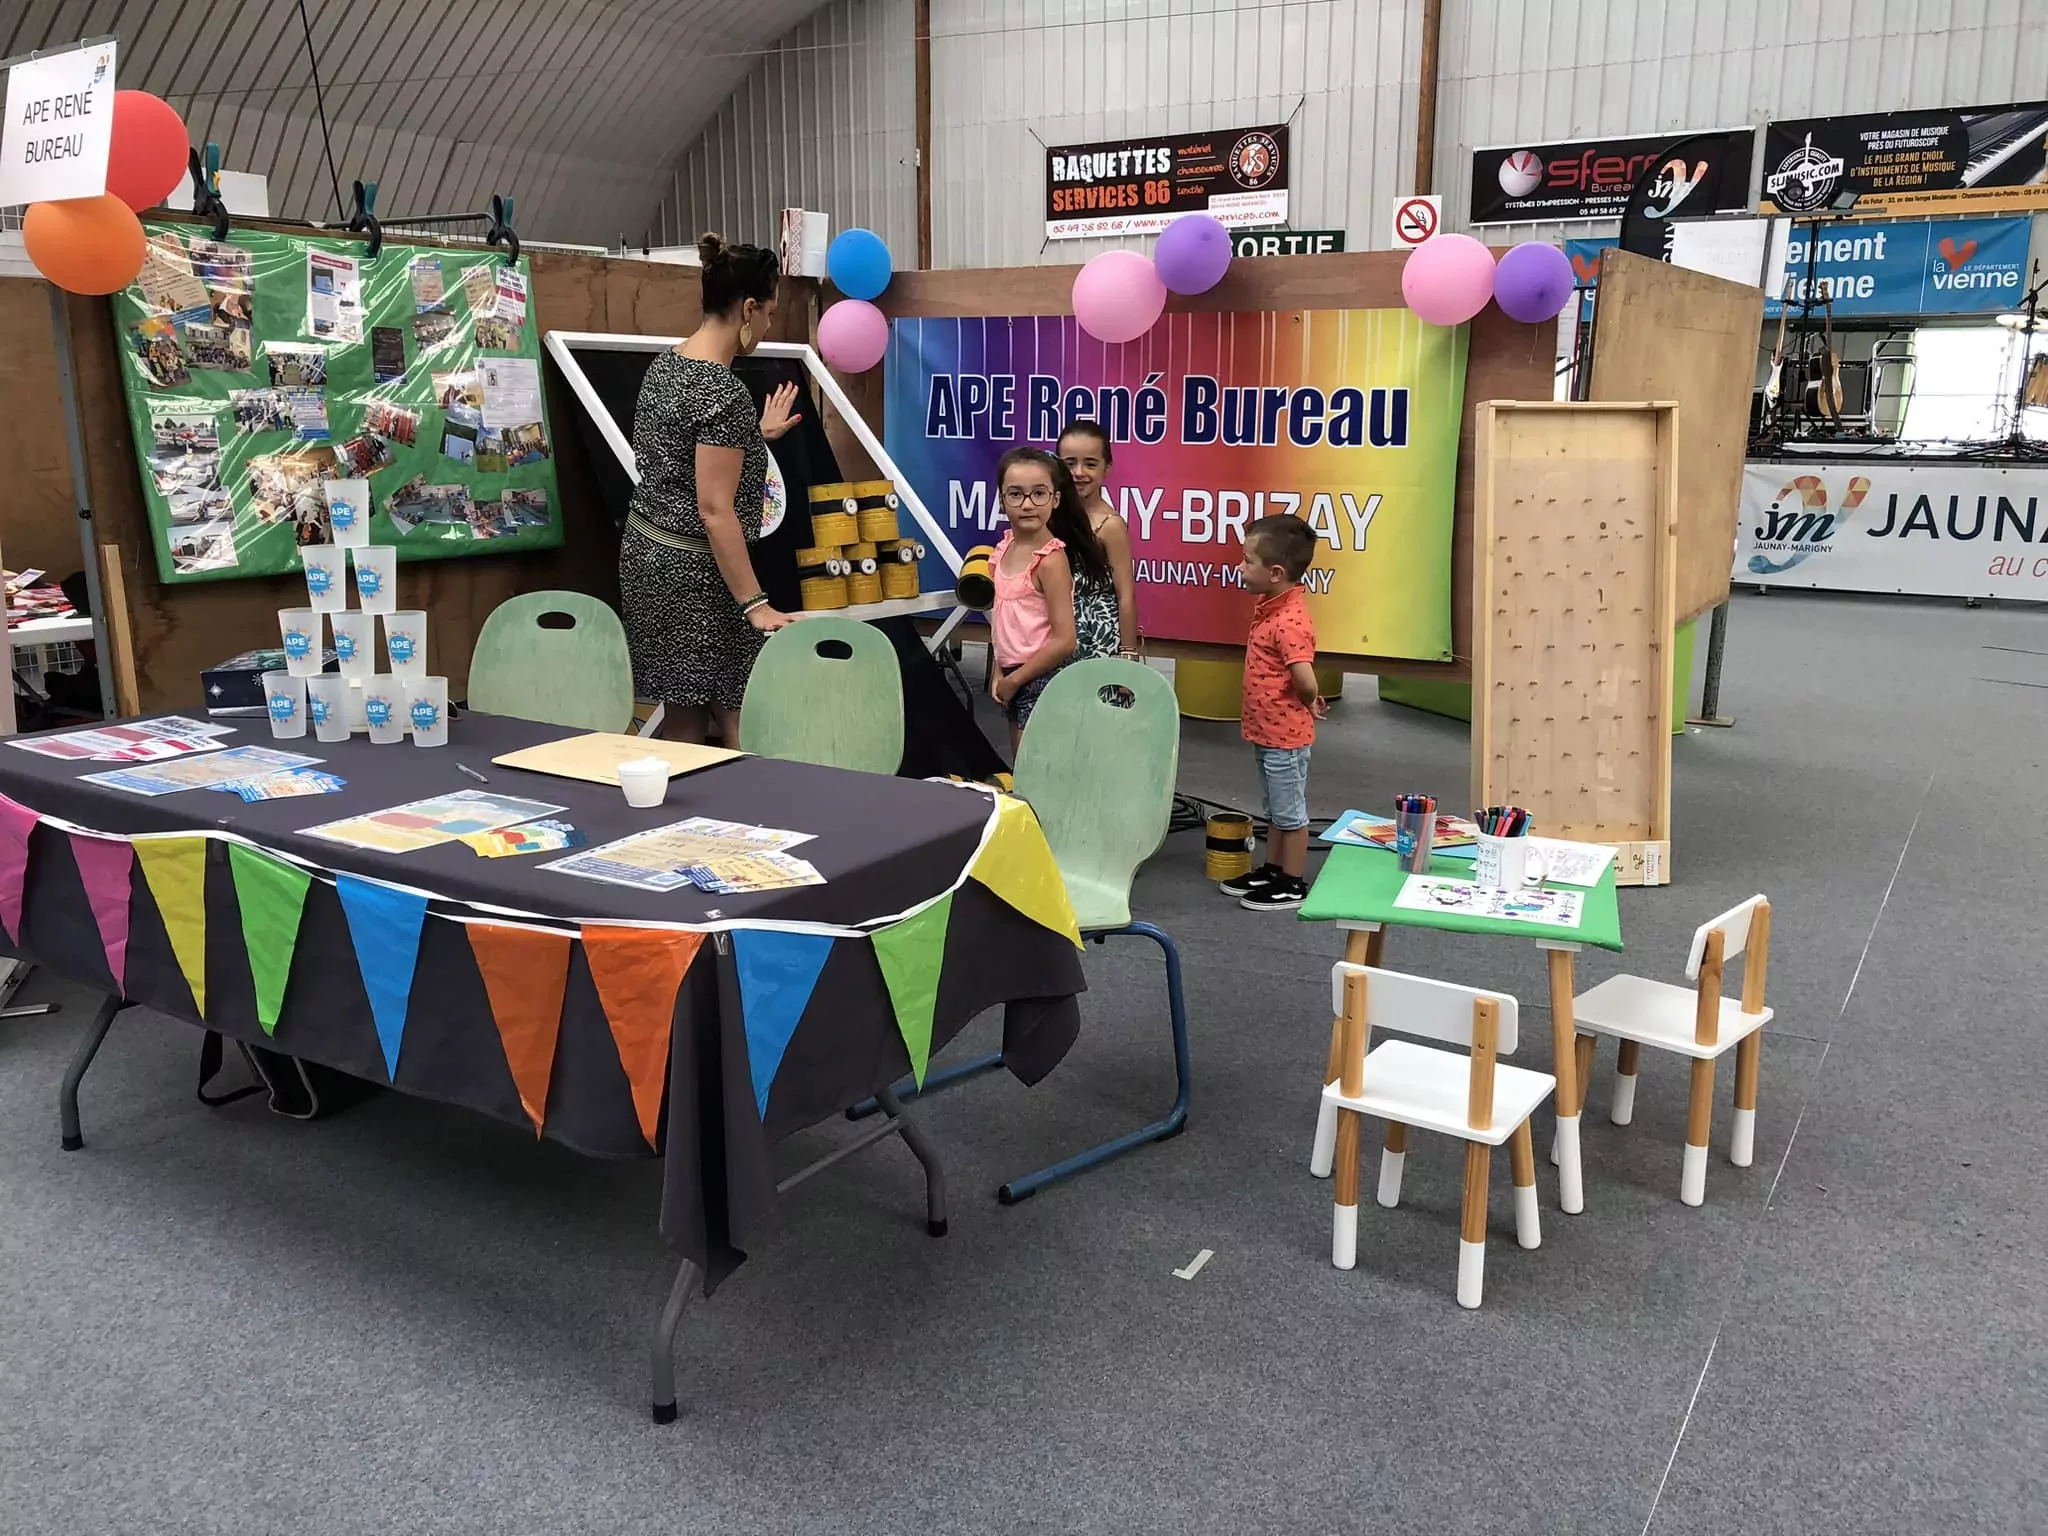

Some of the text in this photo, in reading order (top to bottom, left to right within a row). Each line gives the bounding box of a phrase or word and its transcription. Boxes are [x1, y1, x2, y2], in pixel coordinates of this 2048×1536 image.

[23, 82, 93, 126] APE RENÉ
[1860, 126, 1950, 141] VOTRE MAGASIN DE MUSIQUE
[25, 133, 83, 164] BUREAU
[1885, 141, 1894, 149] DU
[1895, 137, 1940, 149] FUTUROSCOPE
[1864, 150, 1945, 165] LE PLUS GRAND CHOIX
[1052, 146, 1171, 183] RAQUETTES
[1910, 164, 1920, 173] DE
[1922, 161, 1957, 173] MUSIQUE
[1248, 177, 1258, 186] 86
[1873, 178, 1882, 188] DE
[1884, 177, 1894, 187] LA
[1053, 180, 1170, 212] SERVICES 86
[1585, 195, 1612, 205] PRESSES
[1230, 235, 1334, 258] ORTIE
[1786, 231, 1887, 264] ement
[1933, 259, 1945, 273] la
[1933, 270, 2019, 290] vienne
[925, 371, 1411, 448] APE René Bureau
[331, 506, 351, 517] APE
[1753, 541, 1834, 553] JAUNAY-MARIGNY
[1988, 555, 2048, 578] au c
[308, 572, 327, 582] APE
[358, 573, 376, 584] APE
[286, 636, 306, 646] APE
[390, 640, 410, 650] APE
[271, 703, 291, 713] APE
[312, 702, 324, 712] PE
[366, 704, 386, 714] APE
[413, 706, 433, 717] APE
[1398, 834, 1410, 845] PE
